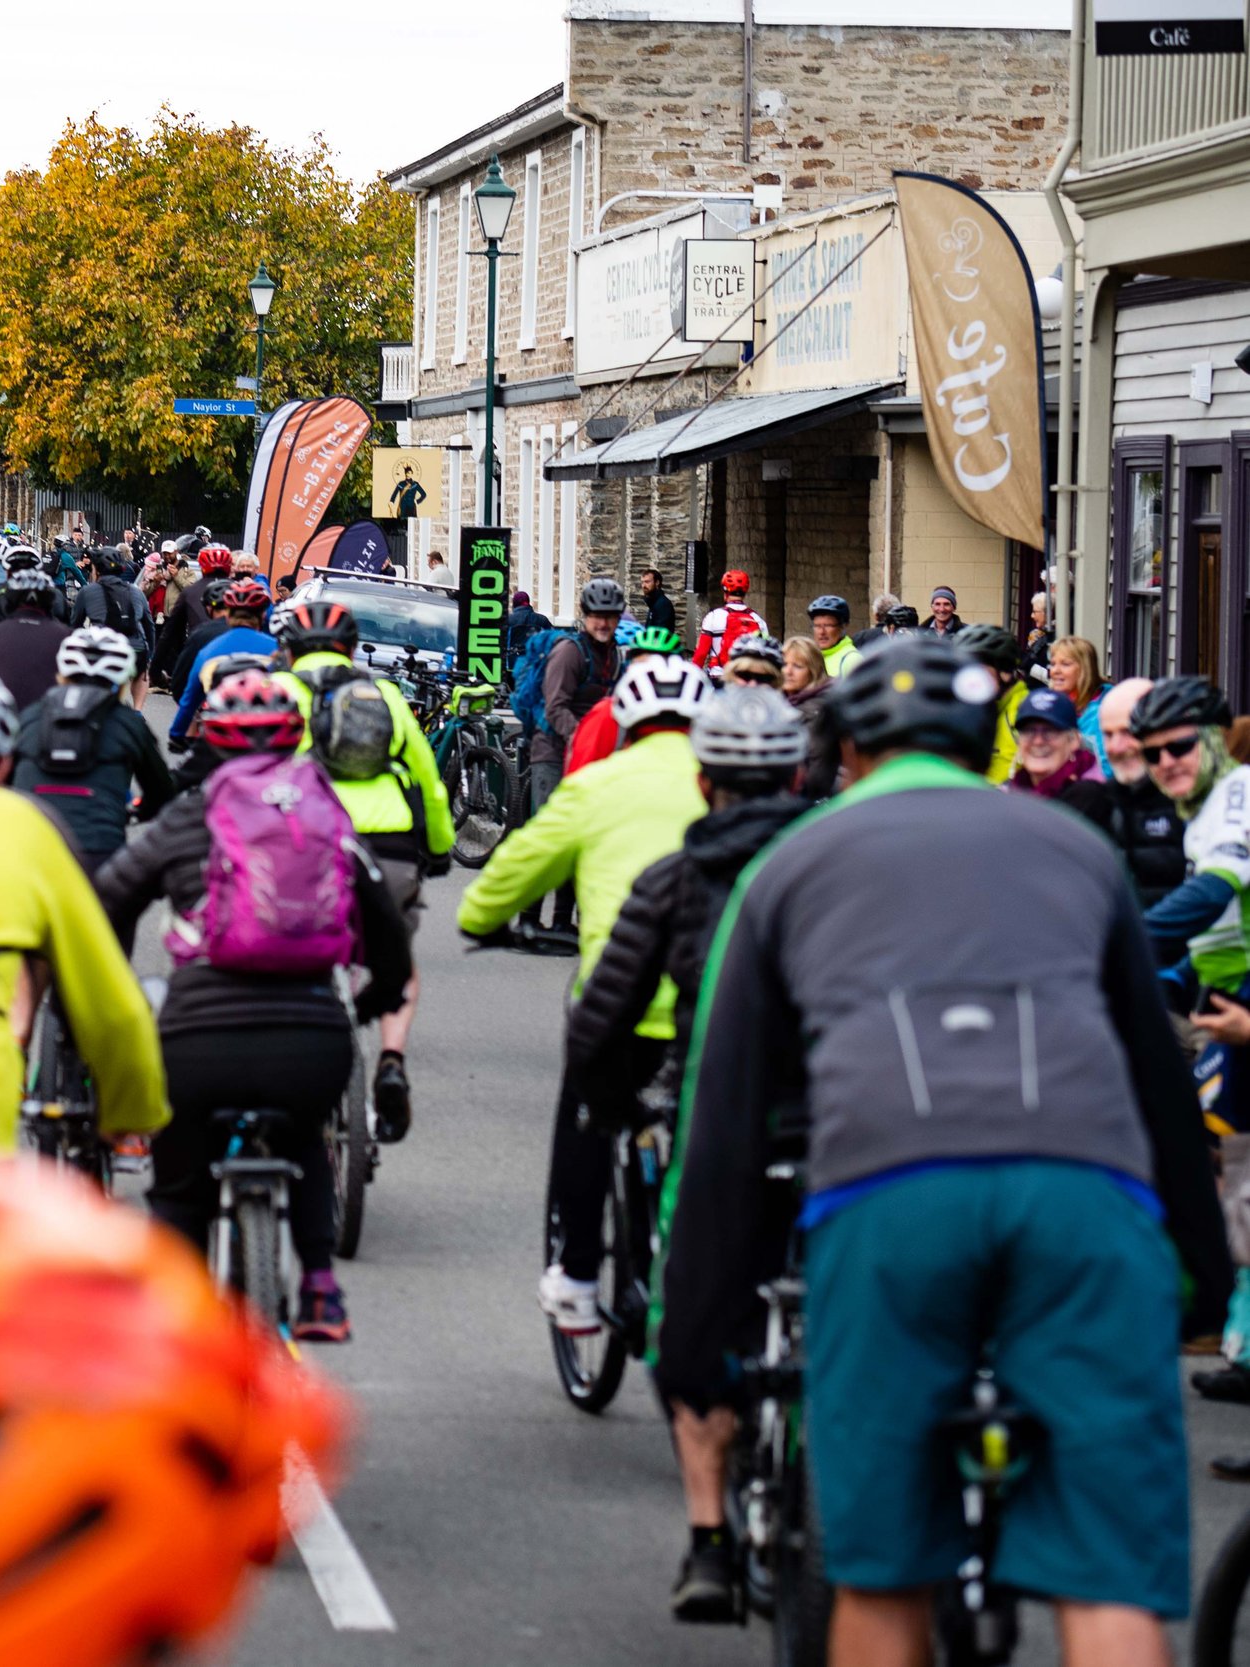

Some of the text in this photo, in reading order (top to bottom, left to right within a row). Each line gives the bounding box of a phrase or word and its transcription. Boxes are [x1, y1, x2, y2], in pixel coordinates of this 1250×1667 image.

[606, 257, 641, 304] CENTRAL
[693, 264, 745, 276] CENTRAL
[693, 277, 746, 299] CYCLE
[772, 233, 864, 305] WINE & SPIRIT
[693, 307, 730, 318] TRAIL
[776, 301, 852, 368] MERCHANT
[193, 402, 236, 412] Naylor St
[291, 420, 349, 509] E-BIKES
[304, 477, 336, 528] RENTALS
[342, 421, 368, 457] SALES
[470, 544, 508, 567] BANK
[467, 569, 505, 684] OPEN
